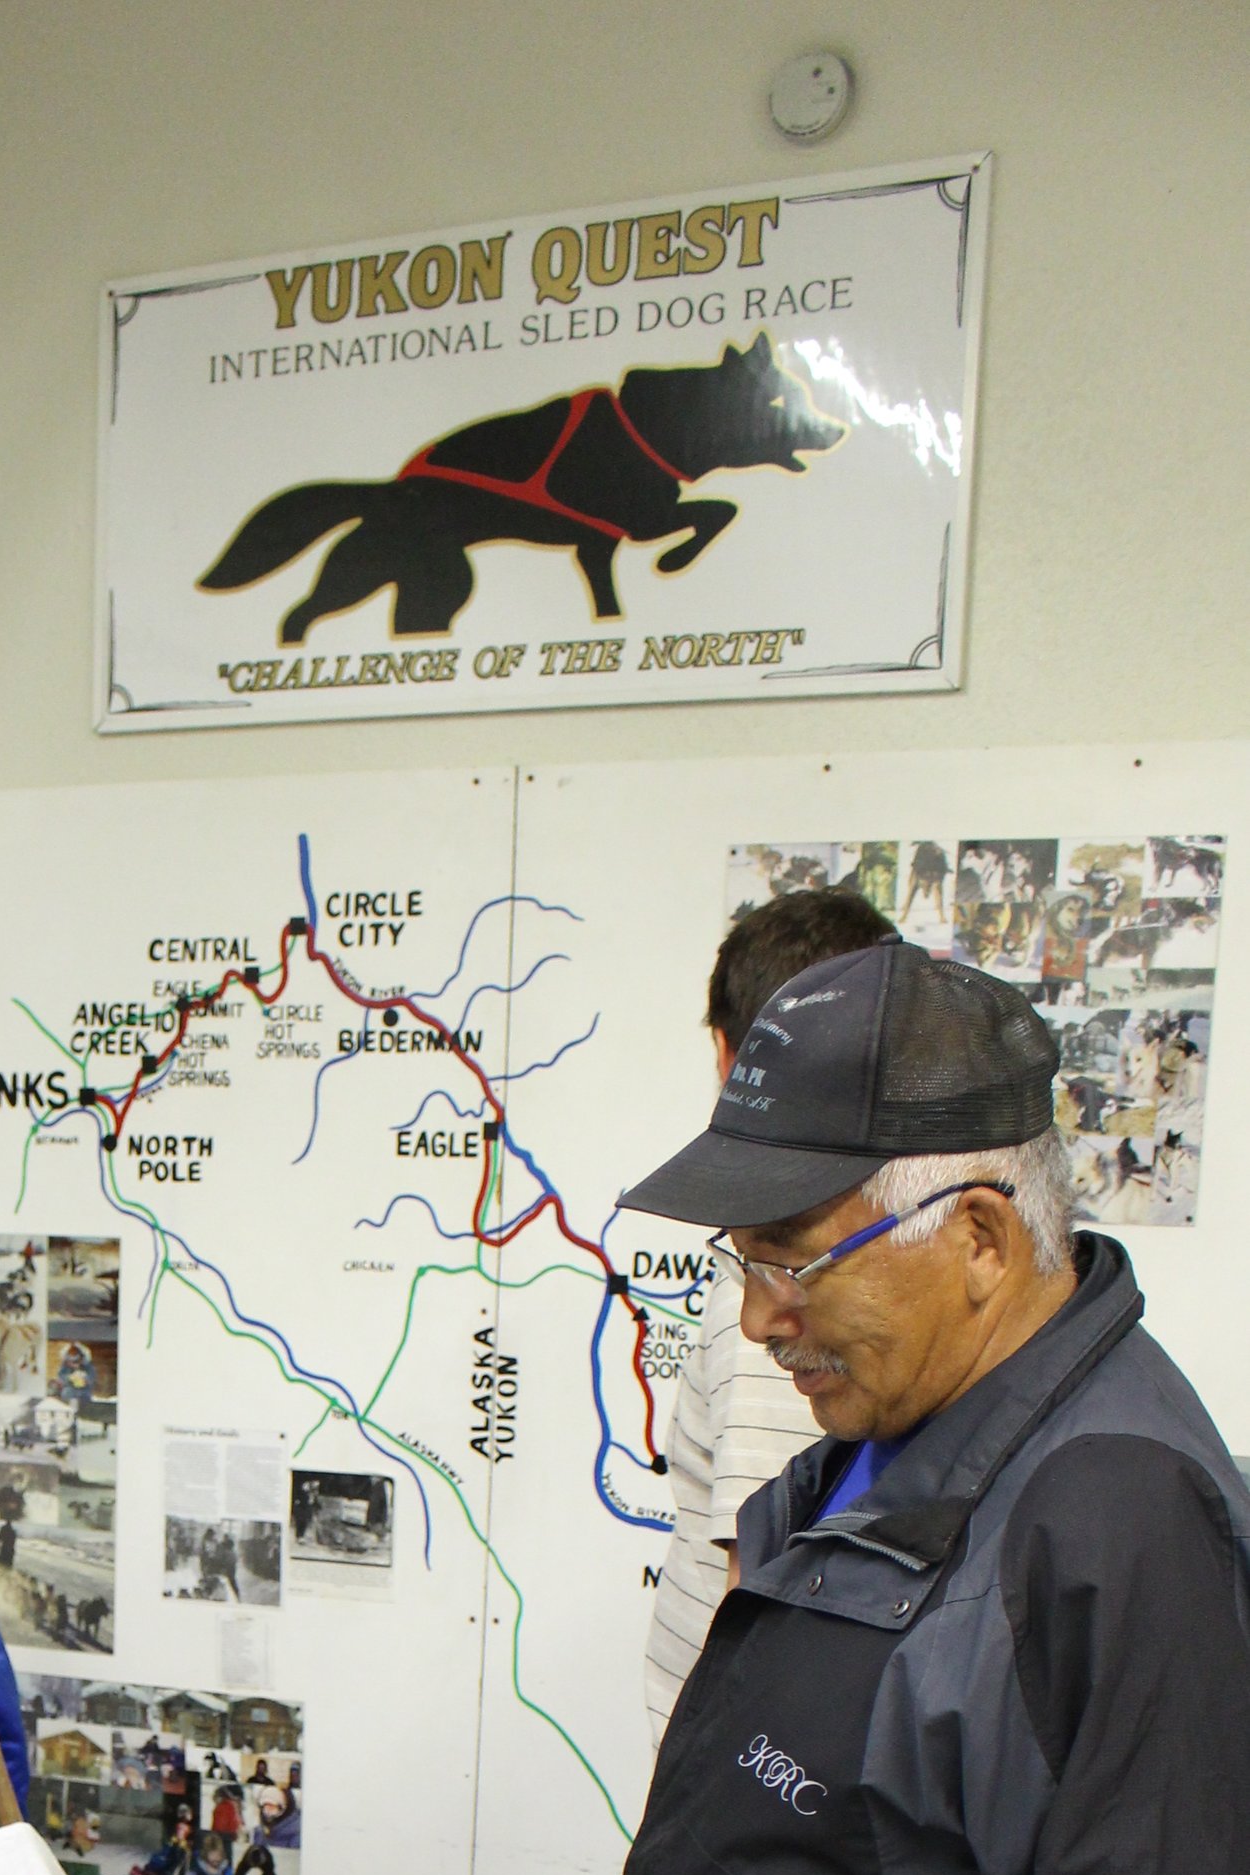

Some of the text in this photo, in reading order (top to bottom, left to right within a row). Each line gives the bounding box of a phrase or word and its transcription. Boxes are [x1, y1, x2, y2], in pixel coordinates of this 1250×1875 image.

[262, 197, 780, 329] YUKON QUEST
[208, 275, 854, 384] INTERNATIONAL SLED DOG RACE
[219, 628, 805, 695] "CHALLENGE OF THE NORTH"
[326, 891, 424, 917] CIRCLE
[339, 923, 405, 947] CITY
[149, 937, 258, 962] CENTRAL
[73, 1003, 150, 1026] ANGEL
[268, 1005, 323, 1022] CIRCLE
[70, 1031, 150, 1055] CREEK
[265, 1024, 294, 1039] HOT
[338, 1030, 482, 1052] BIEDERMAN
[178, 1053, 206, 1067] HOT
[256, 1043, 321, 1059] SPRINGS
[128, 1137, 213, 1156] NORTH
[396, 1131, 479, 1158] EAGLE
[140, 1162, 202, 1182] POLE
[644, 1323, 687, 1340] KING
[641, 1341, 695, 1359] SOLO
[469, 1326, 496, 1460] ALASKA
[494, 1355, 519, 1465] YUKON
